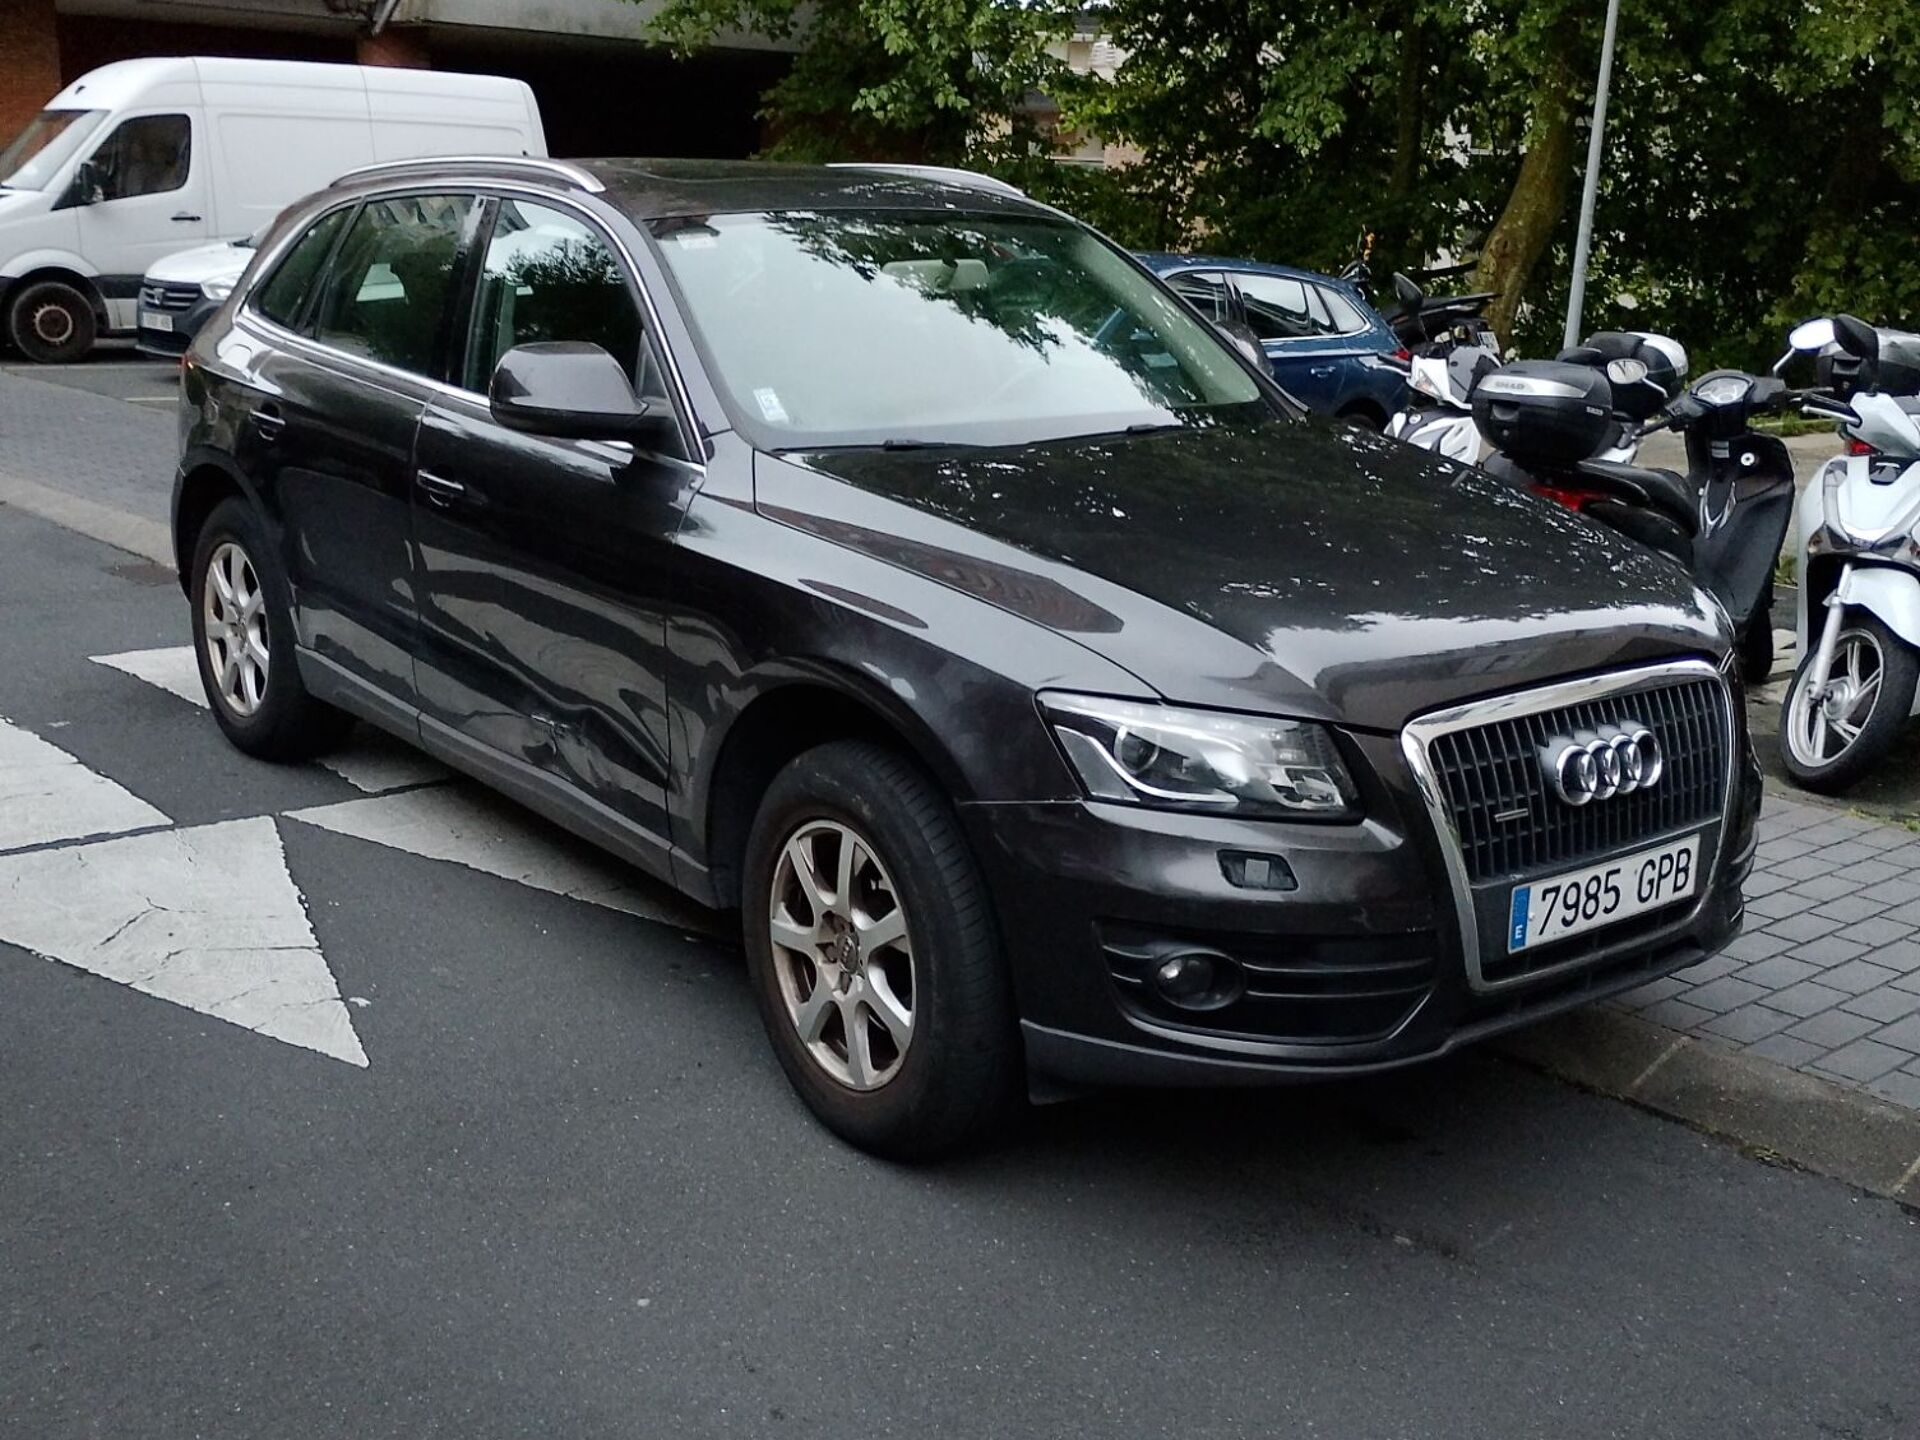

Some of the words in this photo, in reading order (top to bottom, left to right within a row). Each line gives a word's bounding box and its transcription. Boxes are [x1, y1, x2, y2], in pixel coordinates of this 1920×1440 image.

[1538, 868, 1621, 936] 7985
[1637, 848, 1691, 904] GPB
[1514, 924, 1523, 939] E
